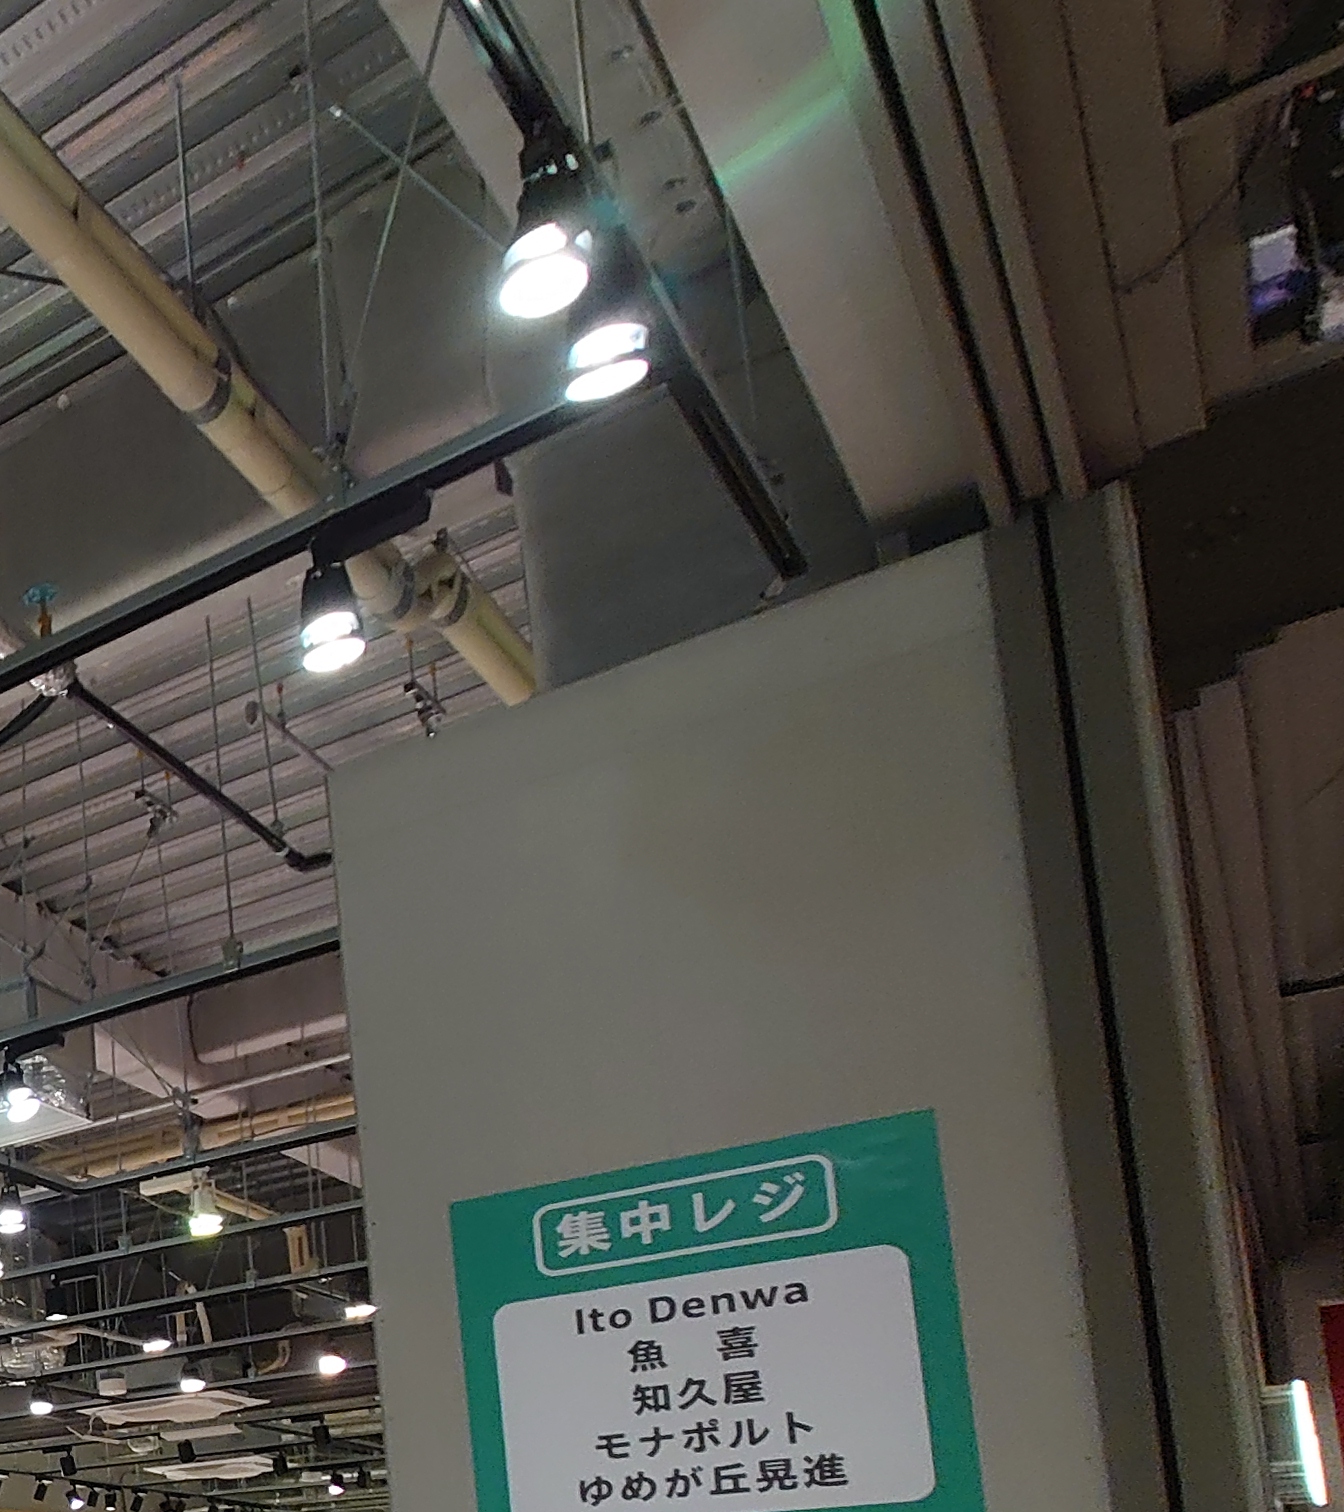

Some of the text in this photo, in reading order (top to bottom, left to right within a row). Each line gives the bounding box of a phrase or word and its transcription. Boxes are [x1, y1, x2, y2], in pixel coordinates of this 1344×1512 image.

[556, 1172, 805, 1258] 集中レジ
[575, 1279, 810, 1336] Ito Denwa
[632, 1370, 765, 1416] 知久屋
[595, 1412, 814, 1459] モナポルト
[579, 1453, 848, 1507] ゆめが丘晃進
